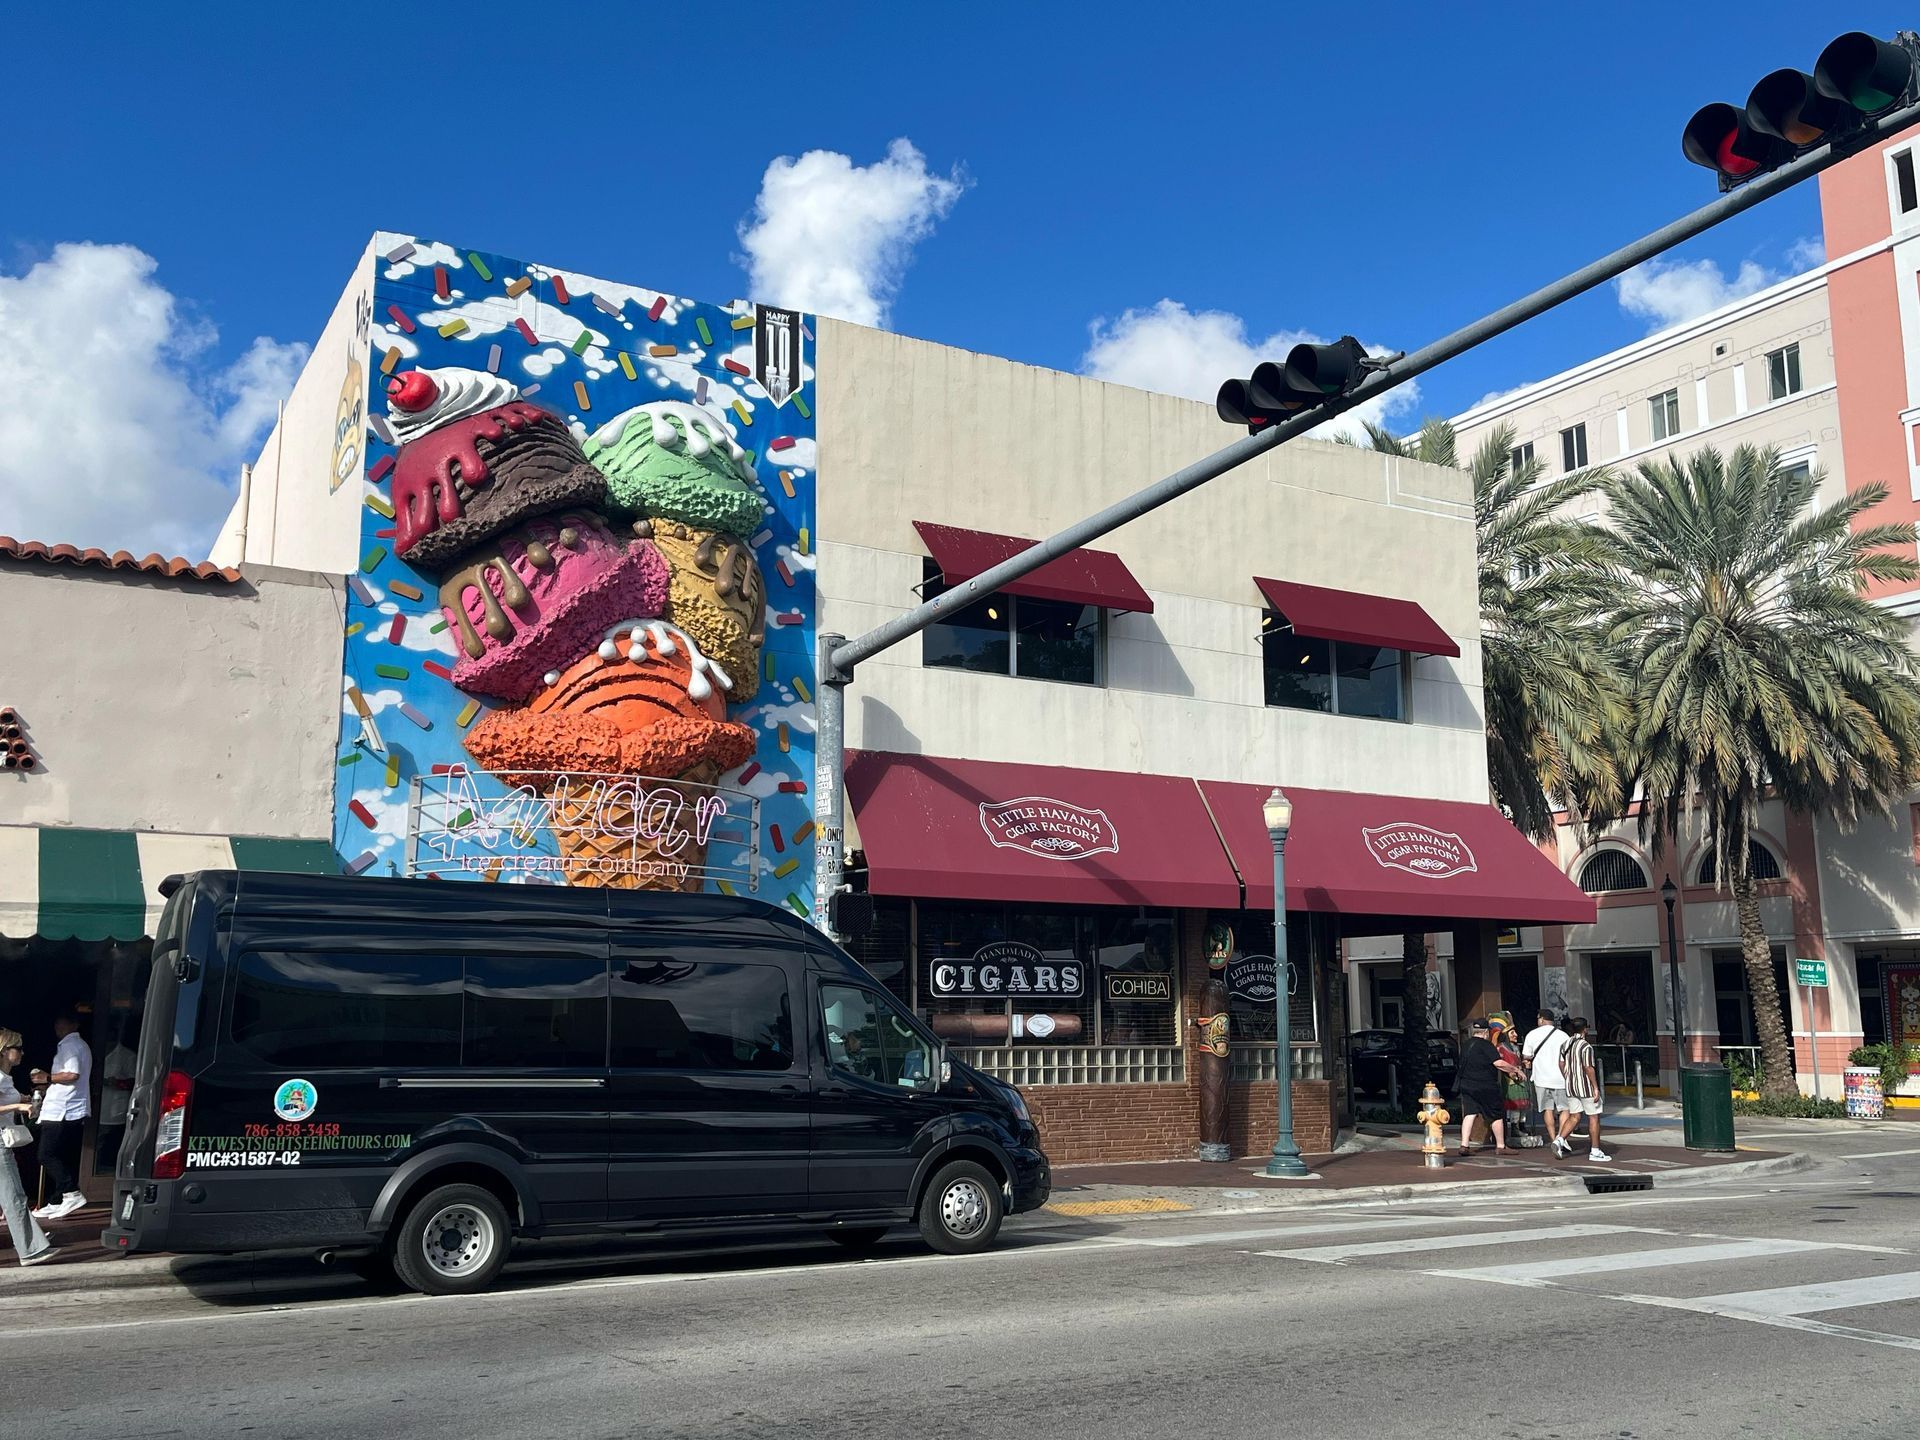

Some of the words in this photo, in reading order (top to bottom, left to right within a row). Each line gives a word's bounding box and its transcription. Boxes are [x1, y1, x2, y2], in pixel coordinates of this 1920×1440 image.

[766, 311, 790, 324] HAPPY
[766, 324, 790, 376] 10
[429, 763, 727, 862] Azucar
[992, 807, 1037, 828] LITTLE
[1038, 807, 1101, 834] HAVANA
[1005, 822, 1040, 839] CIGAR
[1041, 822, 1100, 843] FACTORY
[1374, 832, 1408, 850] LITTLE
[1408, 832, 1460, 854] HAVANA
[1387, 844, 1414, 860] CIGAR
[1412, 844, 1460, 863] FACTORY
[500, 854, 574, 872] cream
[585, 855, 690, 883] company
[980, 947, 1038, 963] HANDMADE
[935, 965, 1080, 993] CIGARS
[1230, 963, 1257, 980] LITTLE
[1257, 963, 1277, 974] HAVA
[1236, 974, 1256, 988] CIGAR
[1256, 973, 1277, 984] FACTO
[1111, 978, 1167, 997] COHIBA
[1291, 1028, 1313, 1040] OPEN
[245, 1123, 340, 1137] 786-858-3458
[188, 1134, 411, 1150] KEYWESTSIGHTSEEINGTOURS.COM
[186, 1151, 300, 1168] PMC#31587-02
